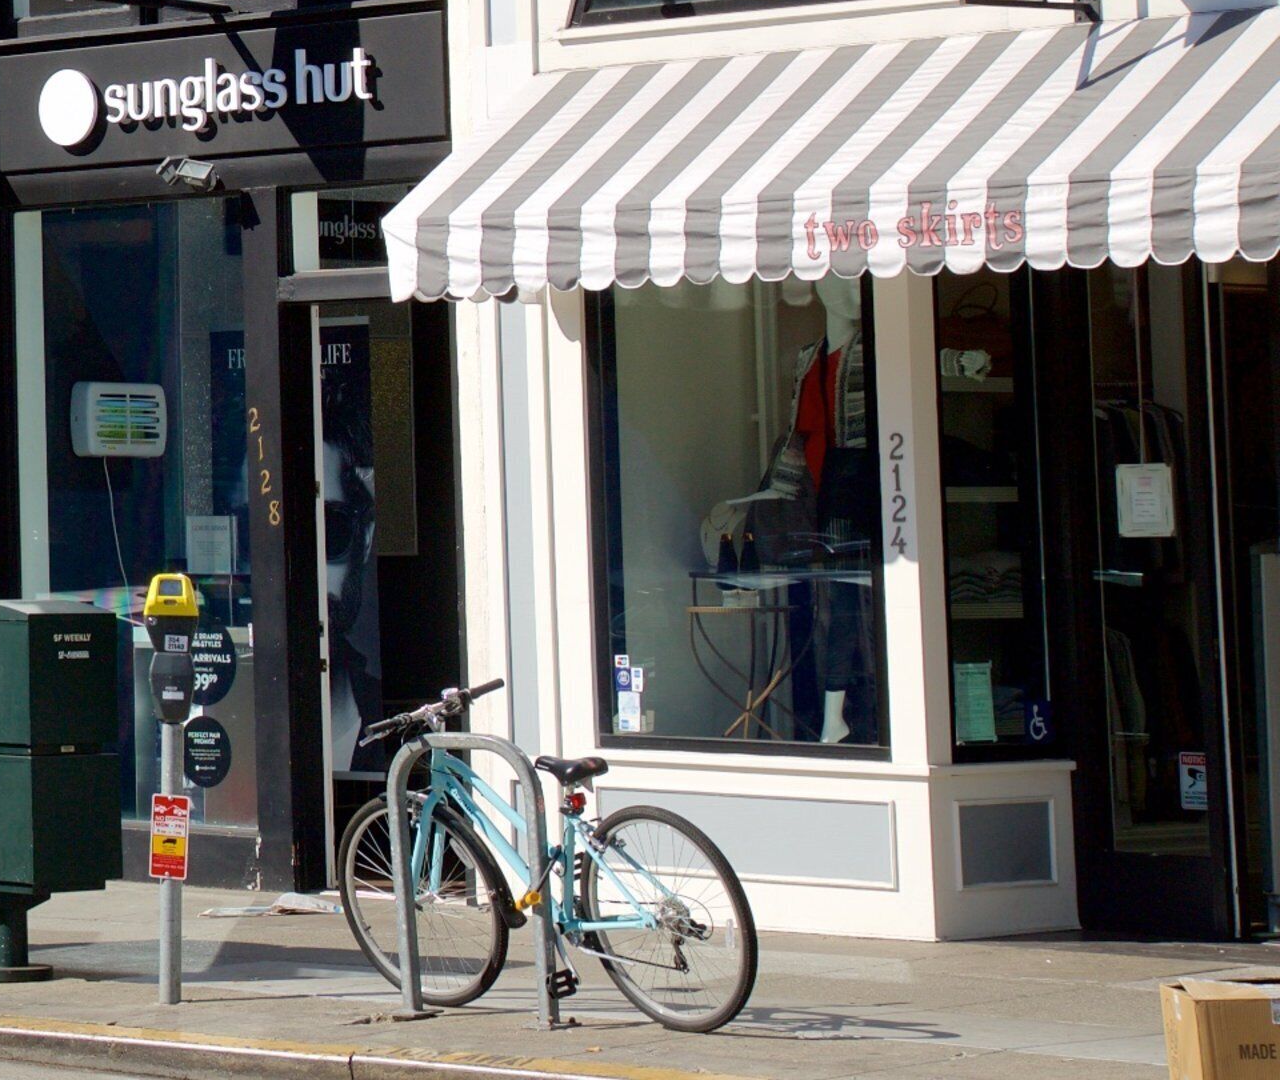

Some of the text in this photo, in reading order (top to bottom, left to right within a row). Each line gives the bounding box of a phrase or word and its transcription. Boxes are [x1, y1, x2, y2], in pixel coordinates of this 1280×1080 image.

[105, 47, 373, 133] sunglass hut
[804, 200, 1025, 261] two skirts
[248, 406, 281, 527] 2128
[889, 432, 907, 556] 2124
[53, 633, 92, 642] SF WEEKLY
[193, 654, 232, 663] ARRIVALS
[1239, 1044, 1277, 1060] MADE
